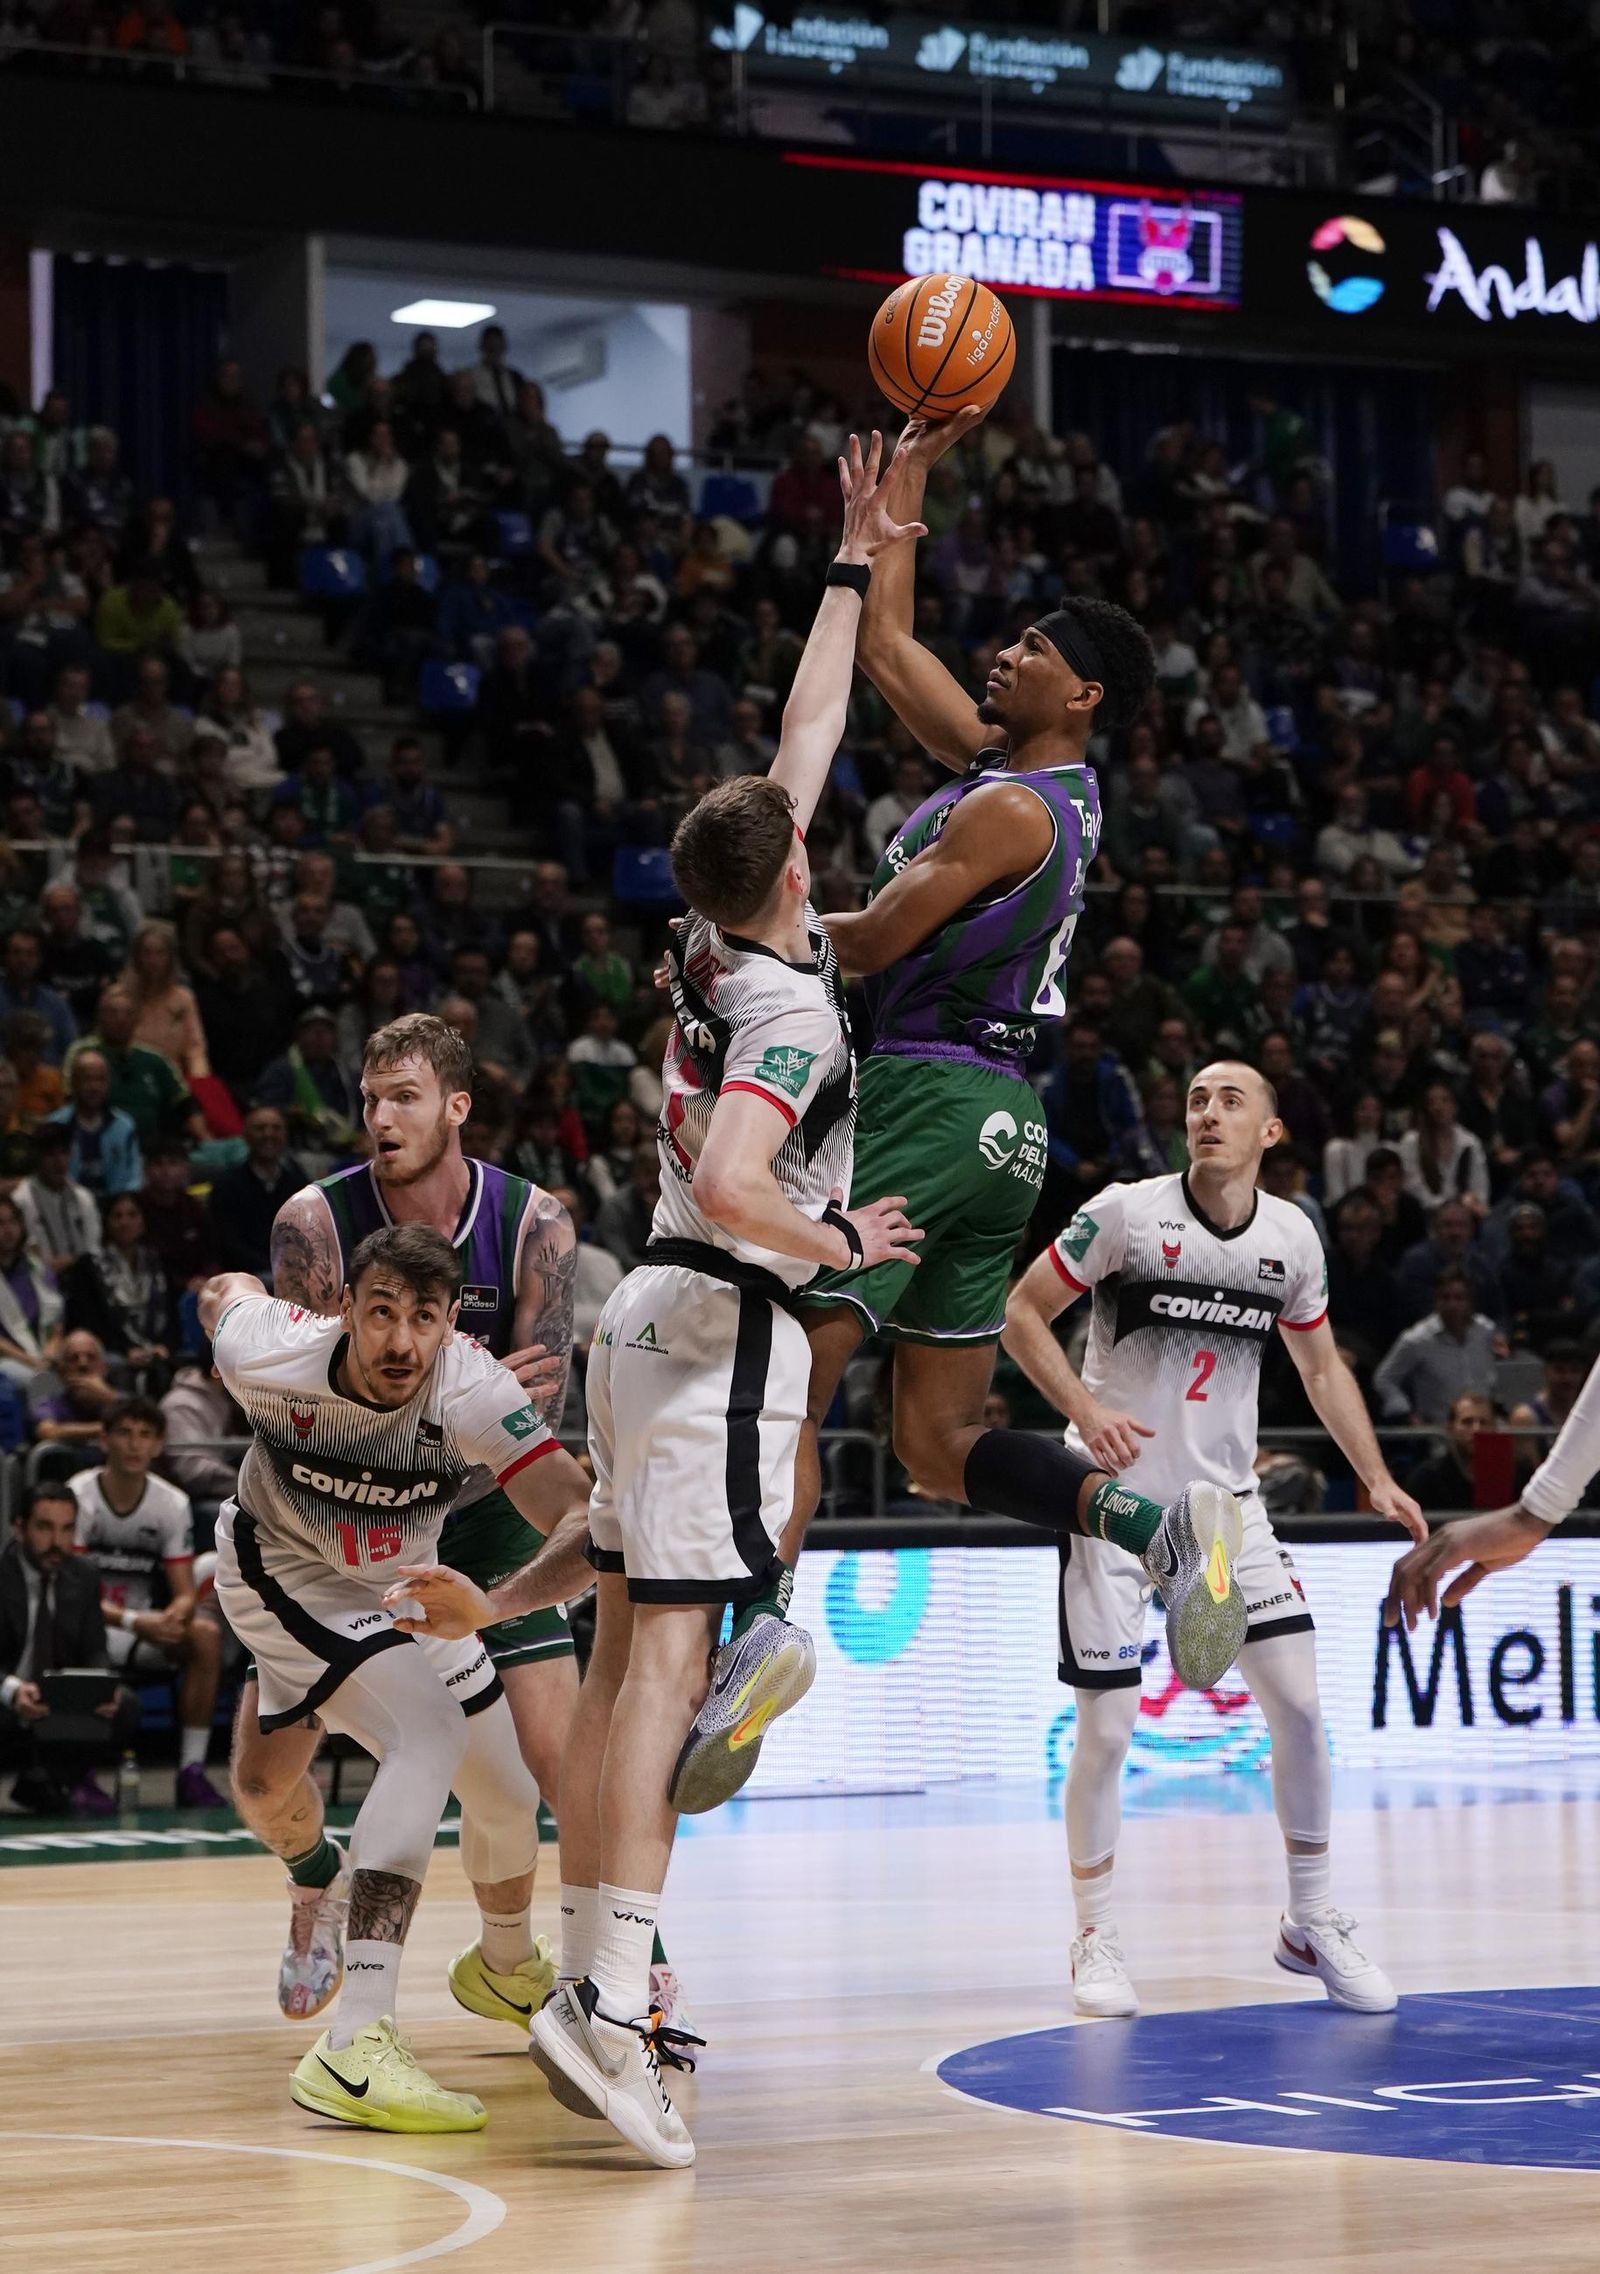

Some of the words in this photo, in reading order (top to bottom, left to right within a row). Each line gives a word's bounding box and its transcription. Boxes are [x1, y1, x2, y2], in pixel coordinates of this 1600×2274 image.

[918, 180, 1095, 244] COVIRAN
[903, 228, 1095, 291] GRANADA
[917, 275, 967, 347] Wilson
[966, 338, 988, 365] liga
[1018, 1143, 1041, 1165] DEL
[1159, 1219, 1186, 1232] vive
[463, 1292, 479, 1301] liga
[463, 1300, 495, 1308] endesa
[1149, 1291, 1278, 1332] COVIRAN
[1185, 1349, 1217, 1402] 2
[292, 1463, 438, 1507] COVIRAN
[335, 1521, 404, 1567] 15
[1246, 1592, 1293, 1614] ERNER
[348, 1613, 382, 1631] vive
[1080, 1647, 1110, 1660] vive
[446, 1651, 488, 1688] ERNER
[612, 1911, 655, 1926] vive
[346, 1961, 385, 1972] vive
[1040, 2076, 1600, 2127] HIG
